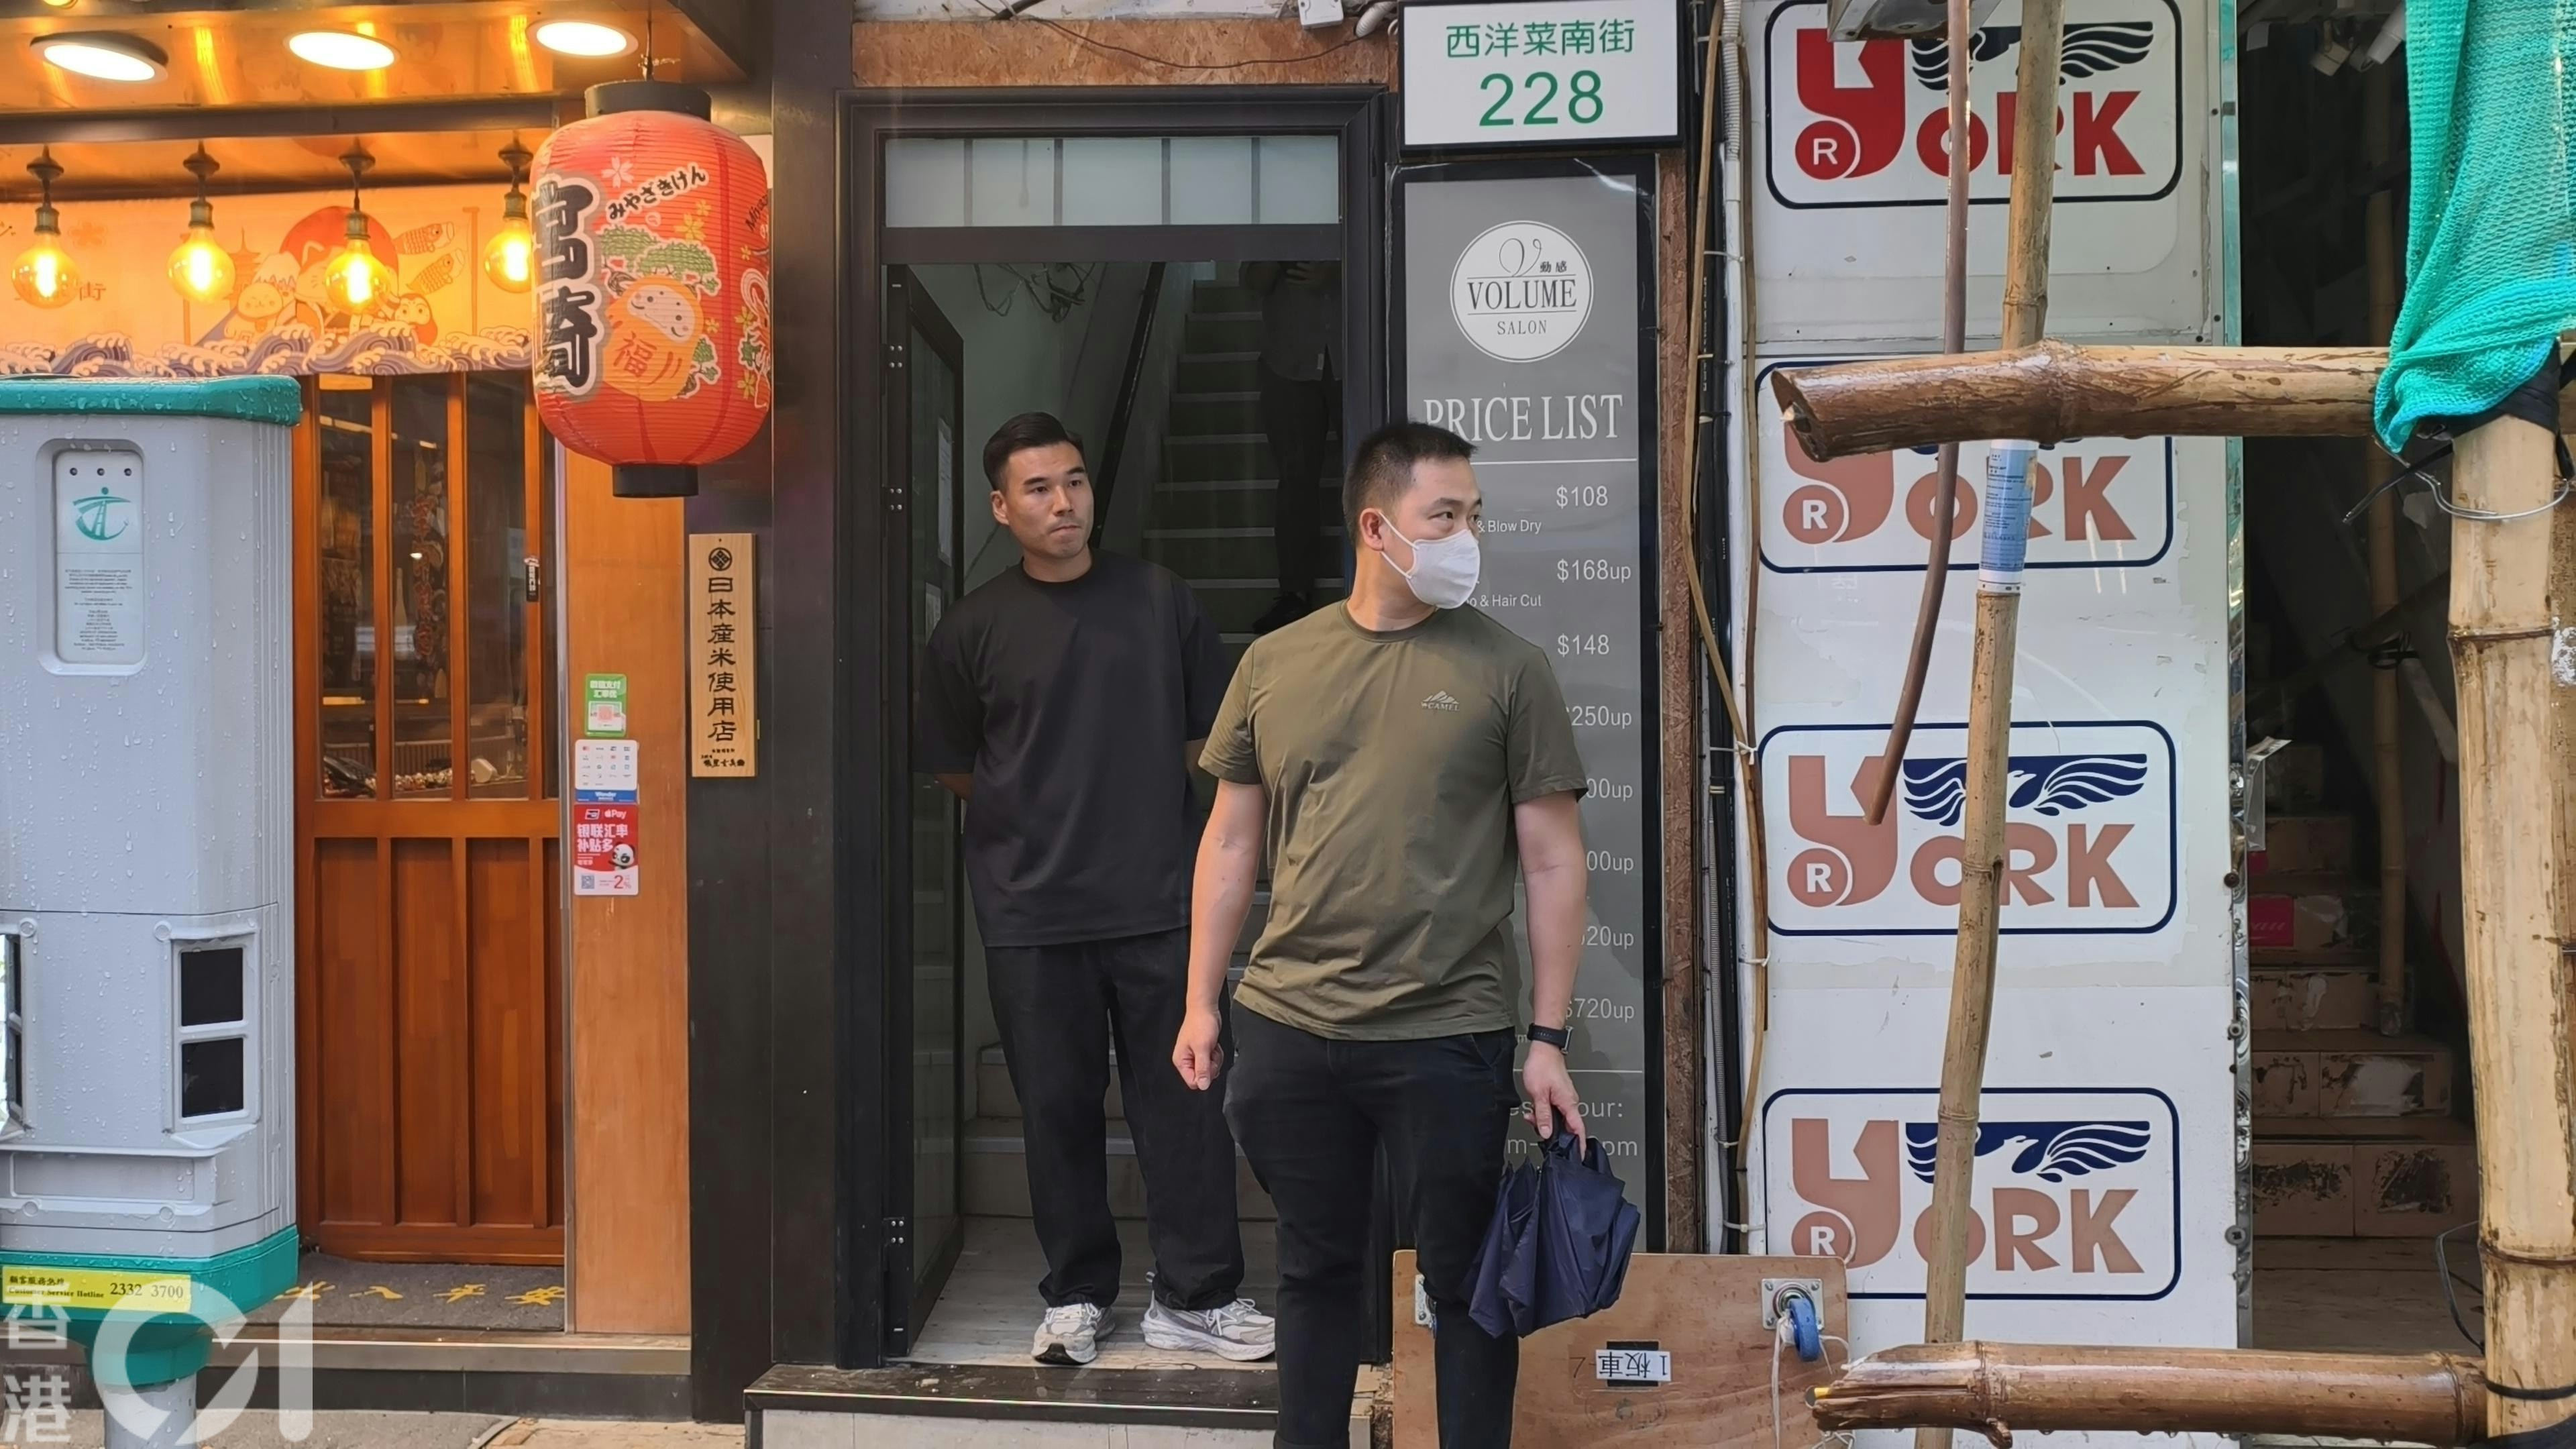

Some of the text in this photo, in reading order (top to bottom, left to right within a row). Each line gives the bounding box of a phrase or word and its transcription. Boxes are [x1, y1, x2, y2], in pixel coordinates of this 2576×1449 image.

[1446, 19, 1635, 58] 西洋菜南街
[1479, 70, 1604, 127] 228
[608, 166, 706, 220] みやざきけん
[1467, 279, 1577, 311] VOLUME
[1497, 320, 1547, 335] SALON
[613, 331, 657, 379] 福
[1424, 394, 1623, 442] PRICE LIST
[1556, 485, 1609, 509] $108
[1488, 520, 1517, 533] Blow
[1520, 519, 1542, 535] Dry
[1557, 558, 1631, 583] $168up
[1480, 594, 1489, 607] &
[1492, 594, 1517, 607] Hair
[1557, 633, 1610, 658] $148
[706, 576, 737, 742] 日本産米使用店
[1566, 706, 1632, 729] 250up
[612, 809, 627, 820] Pay
[577, 823, 629, 839] 银联汇率
[577, 838, 614, 853] 补贴多
[1580, 1100, 1623, 1118] our:
[8, 1287, 105, 1299] Customer Service Hotline
[110, 1283, 184, 1299] 2332 3700
